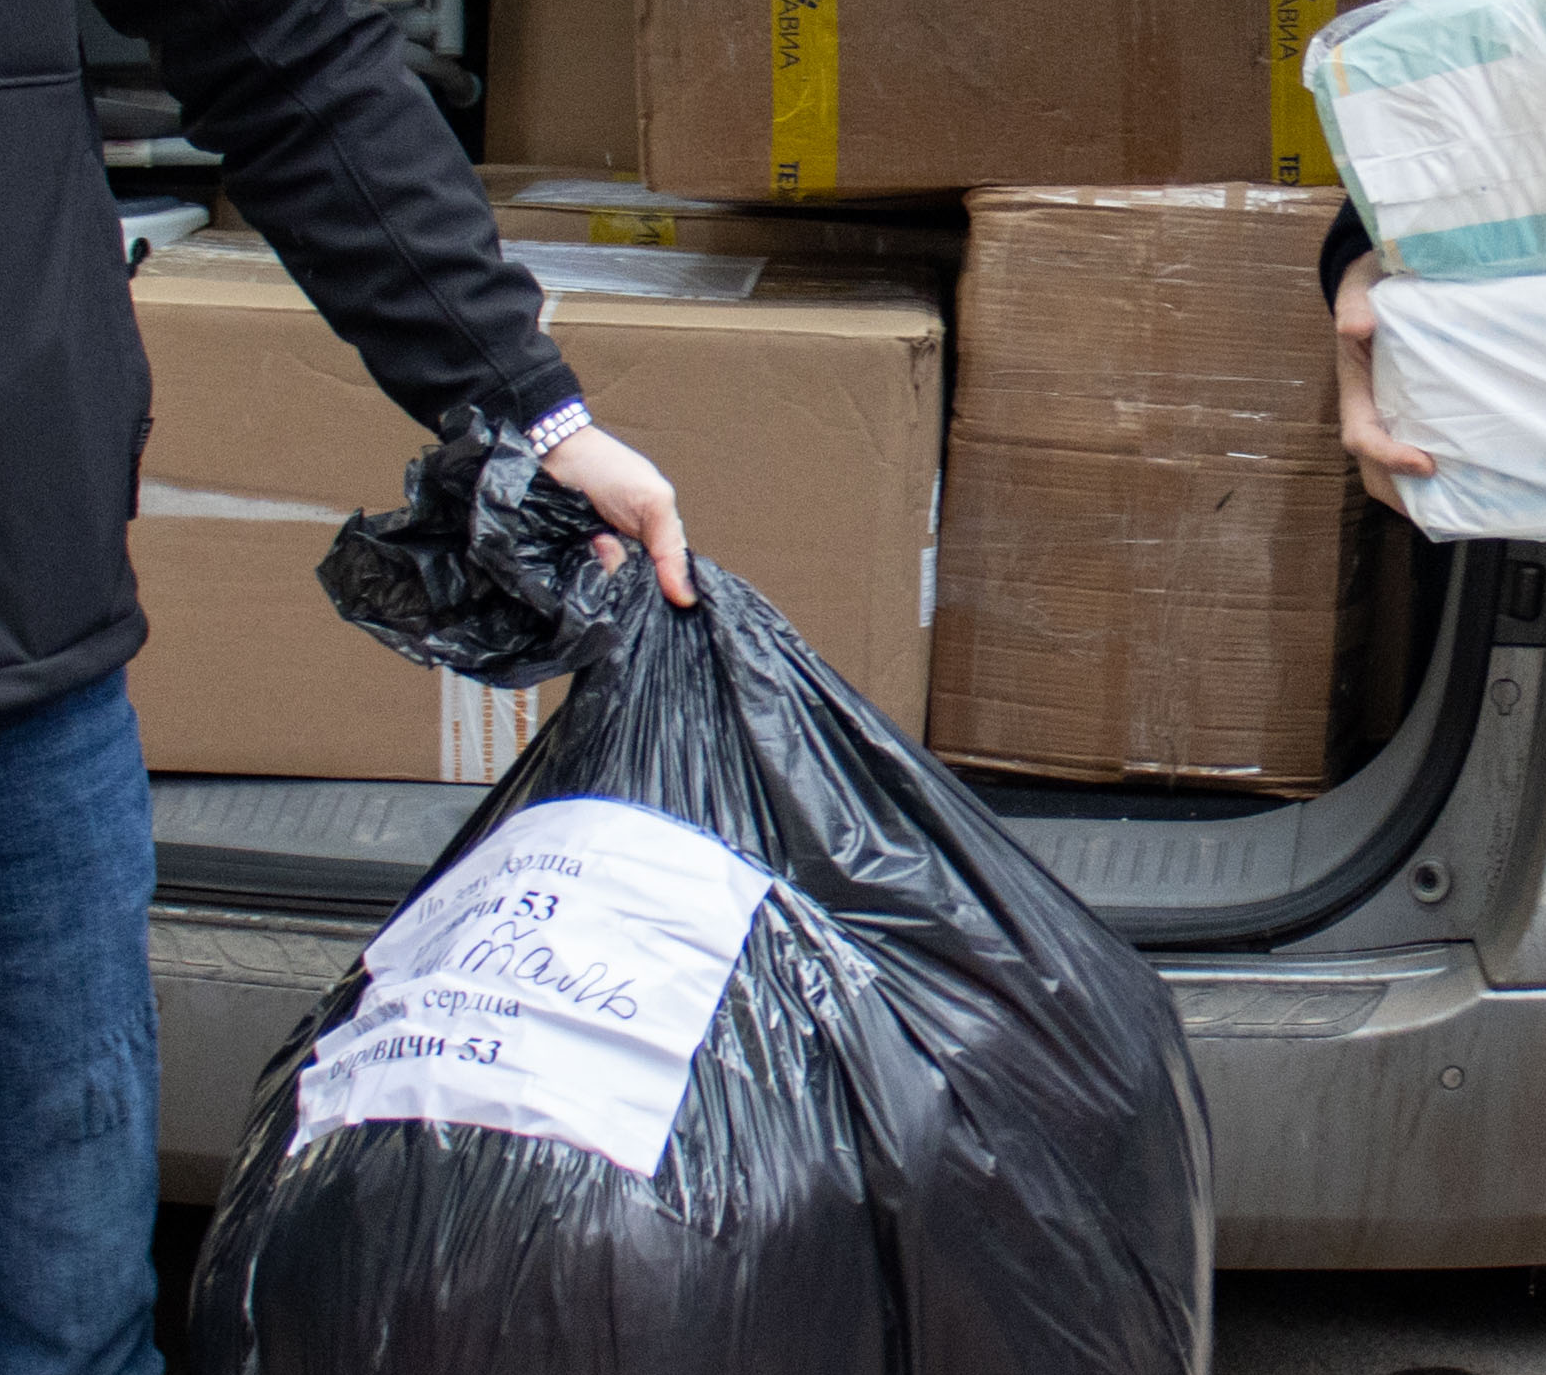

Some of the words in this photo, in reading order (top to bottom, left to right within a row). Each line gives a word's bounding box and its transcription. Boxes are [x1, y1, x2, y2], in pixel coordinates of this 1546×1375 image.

[513, 891, 560, 921] 53
[423, 987, 521, 1017] сердца
[458, 1037, 502, 1065] 53
